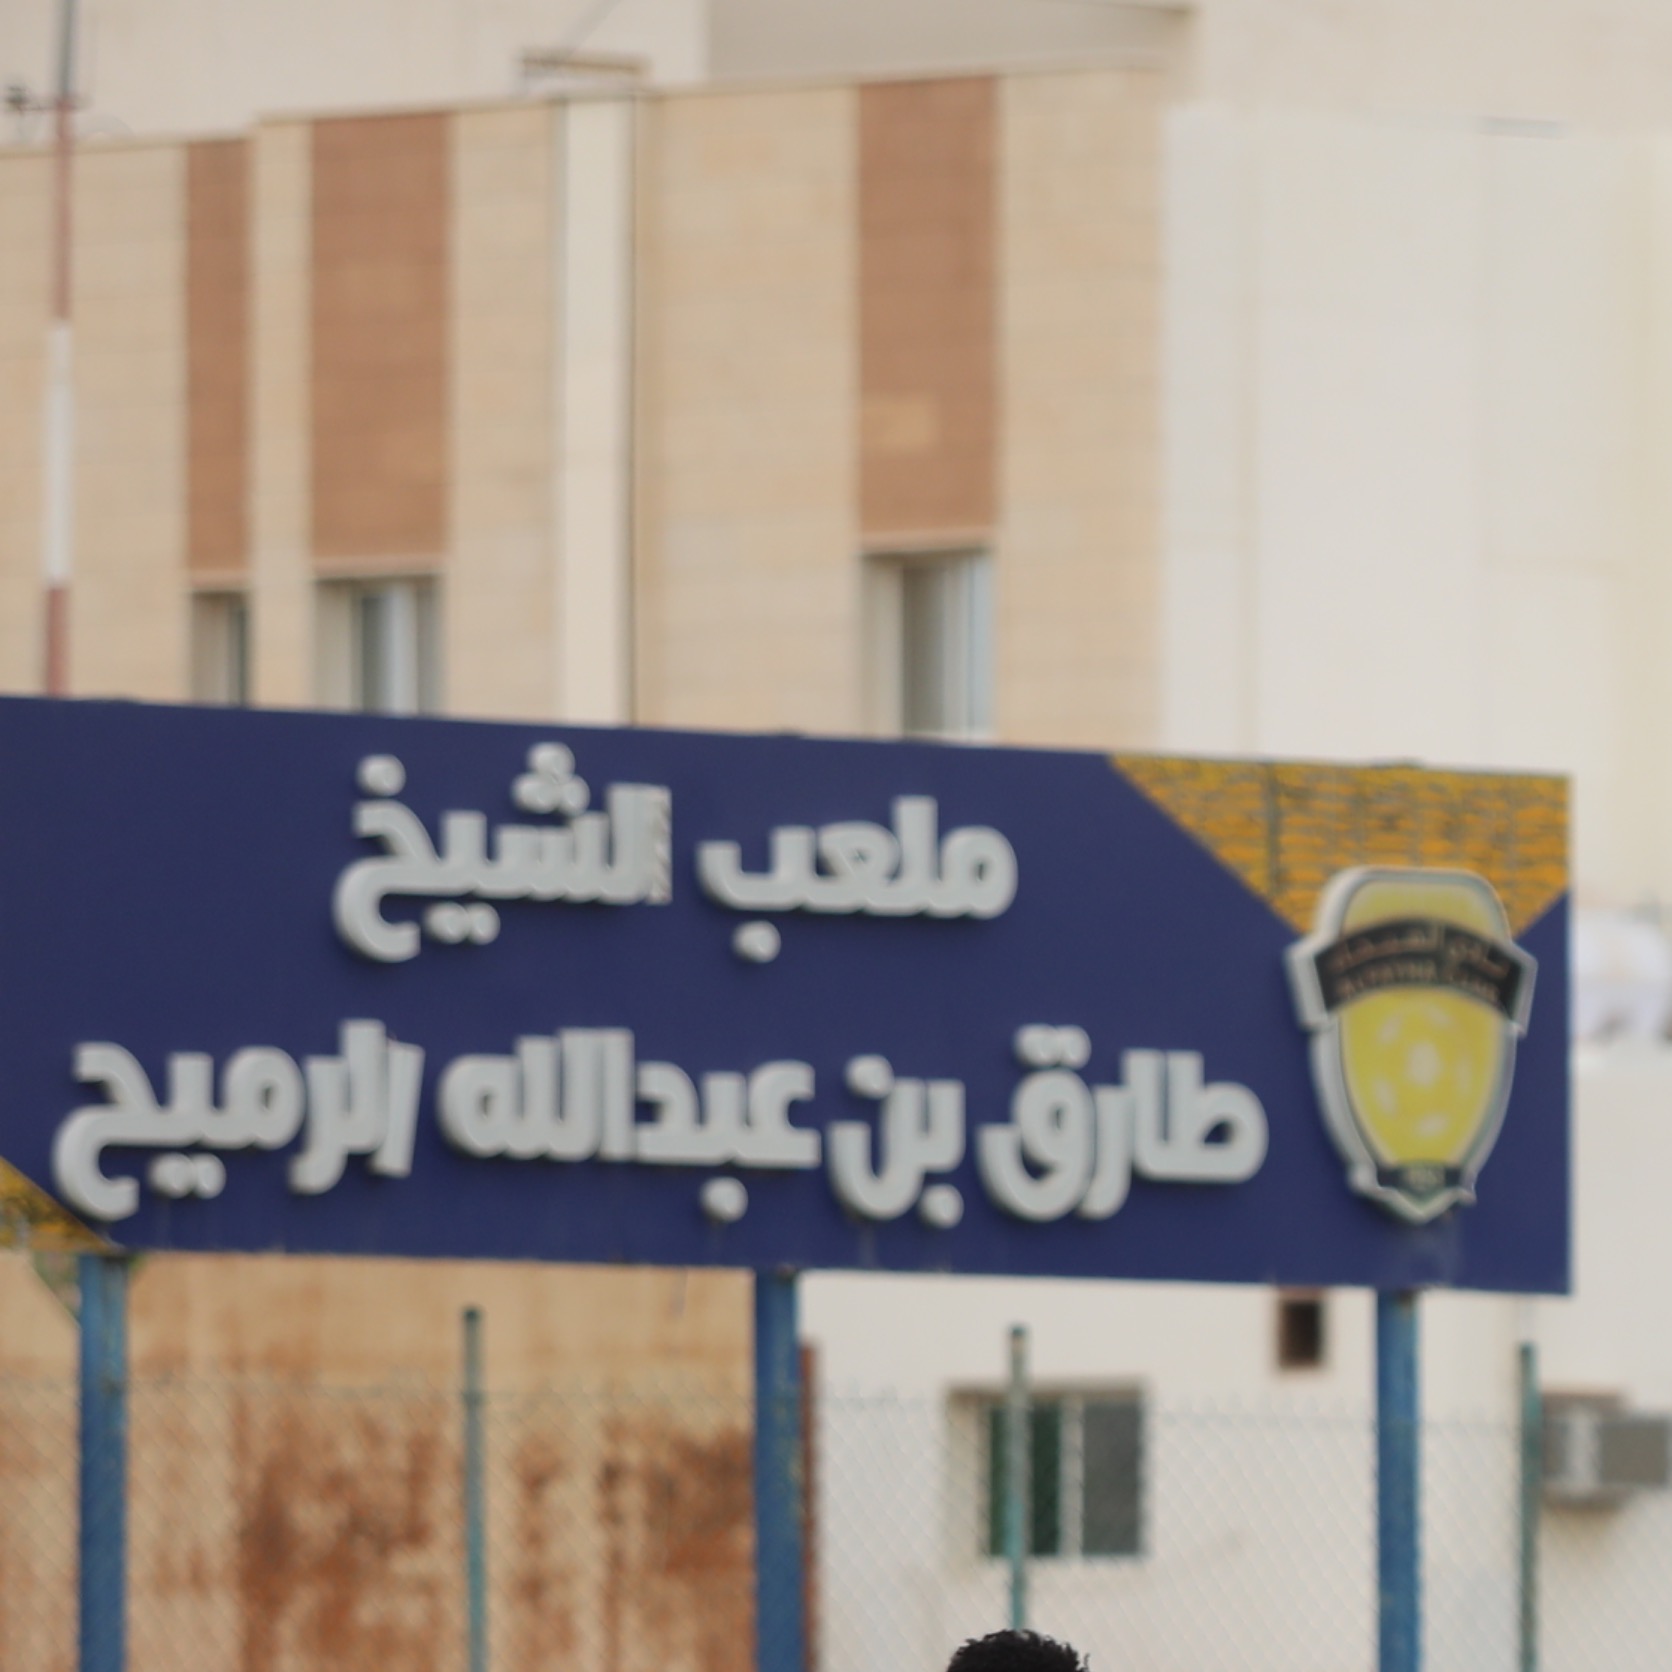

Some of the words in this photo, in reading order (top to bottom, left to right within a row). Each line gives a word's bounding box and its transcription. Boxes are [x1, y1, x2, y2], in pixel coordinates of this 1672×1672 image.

[332, 742, 672, 961] الشيخ
[697, 797, 1016, 960] ملعب
[52, 1019, 425, 1219] الرميح
[438, 1027, 821, 1220] عبدالله
[826, 1055, 965, 1227] بن
[977, 1024, 1268, 1220] طارق
